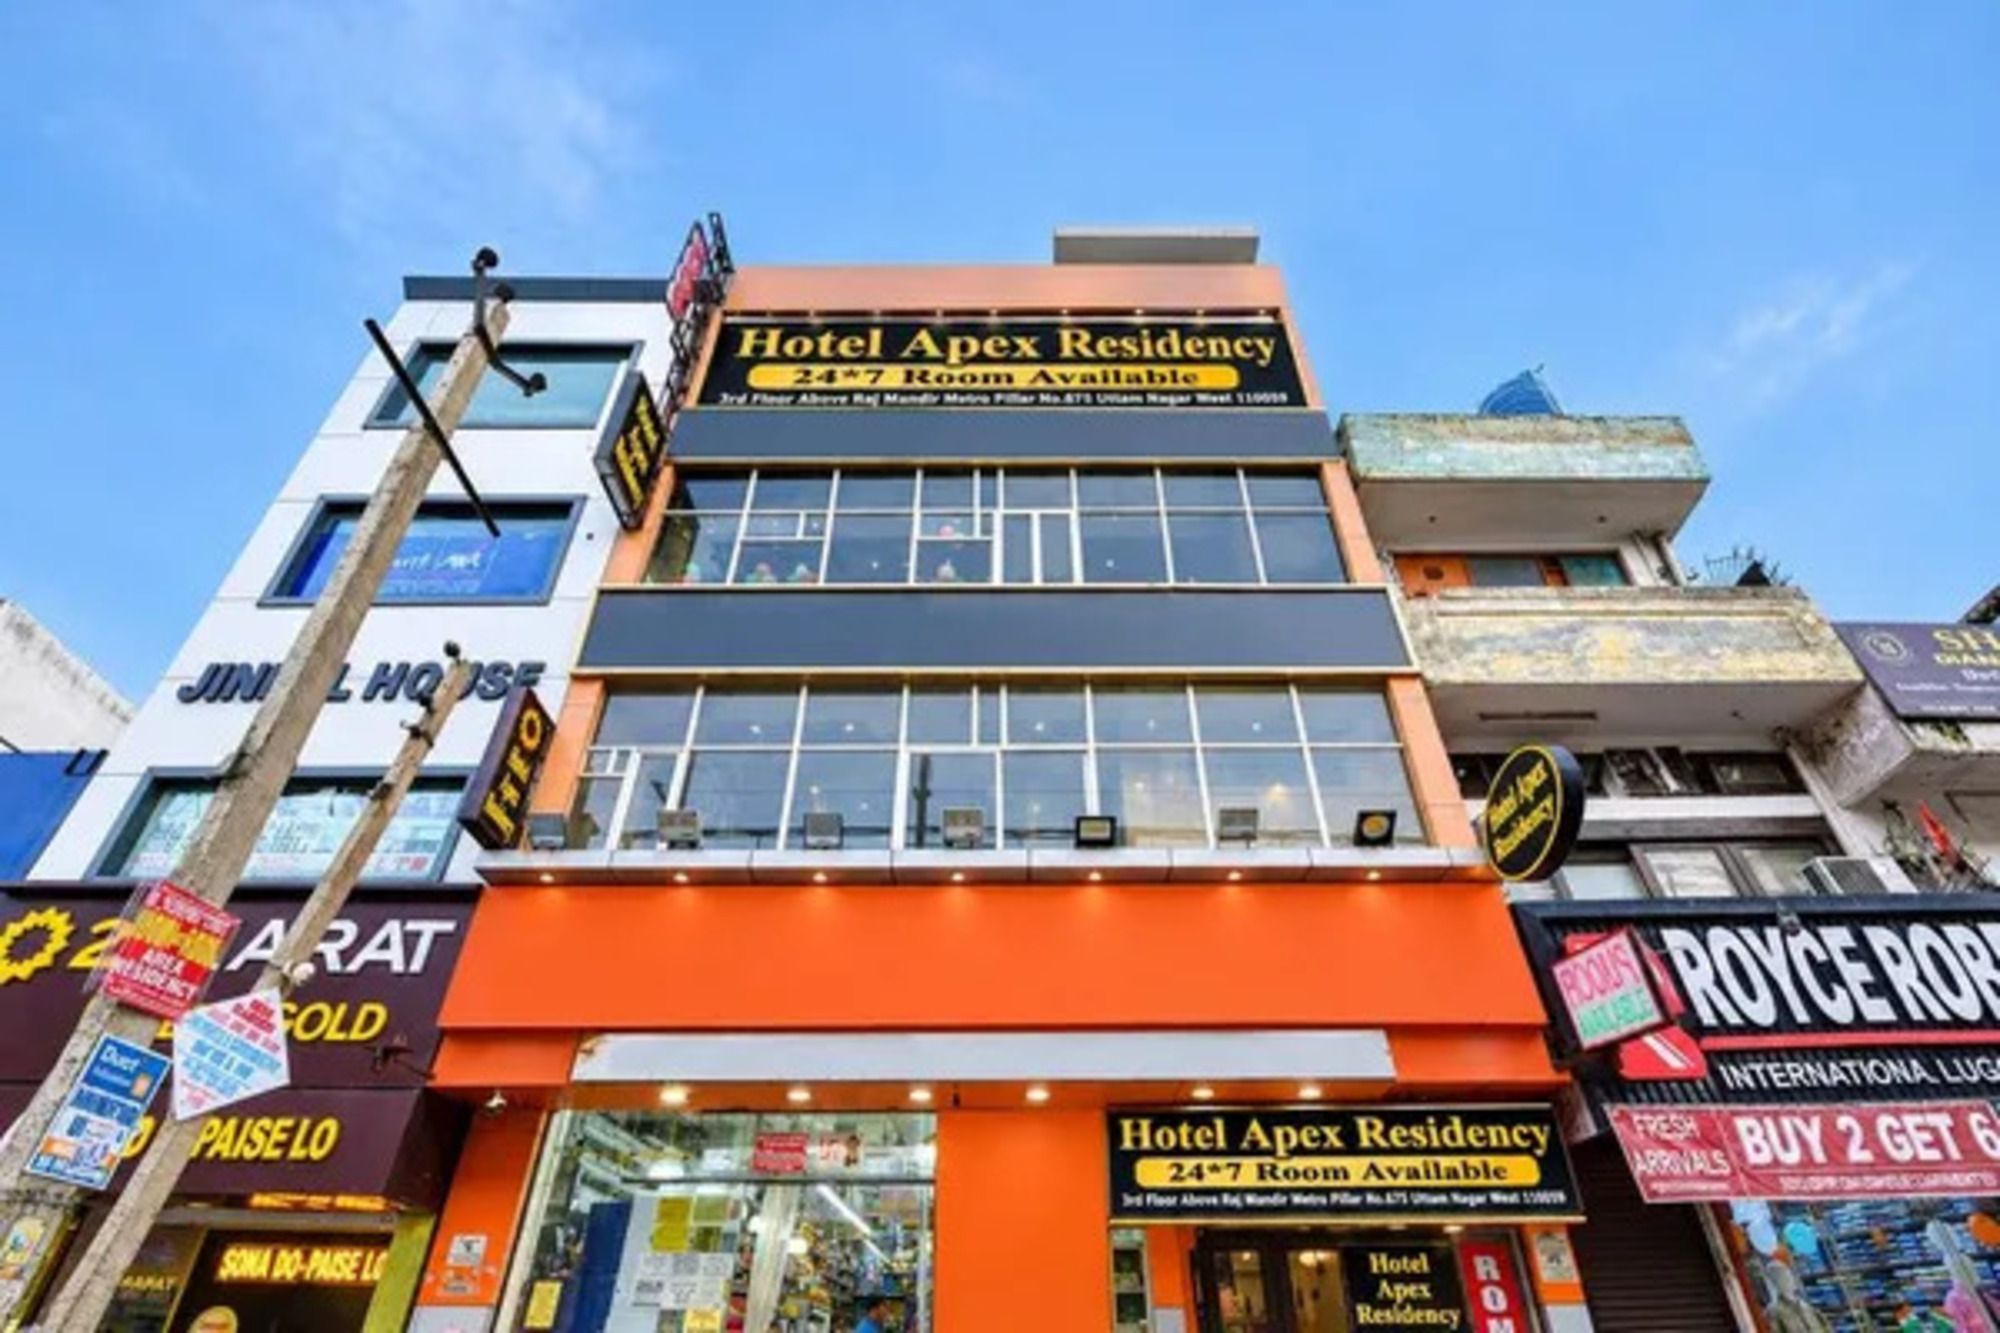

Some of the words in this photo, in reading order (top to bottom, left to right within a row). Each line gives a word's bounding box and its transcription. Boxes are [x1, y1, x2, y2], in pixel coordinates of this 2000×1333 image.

[734, 327, 883, 359] Hotel
[901, 328, 1042, 364] Apex
[1058, 328, 1275, 367] Residency
[903, 368, 1014, 385] Room
[1028, 368, 1199, 386] Available
[176, 662, 353, 703] JINL
[1658, 925, 1899, 1027] ROYCE
[1861, 922, 2000, 1022] ROB
[1935, 1056, 2000, 1084] LUG
[287, 1116, 340, 1161] LO
[1119, 1117, 1227, 1150] Hotel
[1240, 1117, 1346, 1159] Apex
[1353, 1115, 1549, 1157] Residency
[1632, 1111, 1702, 1142] FRESH
[1733, 1113, 1828, 1166] BUY
[1834, 1113, 1875, 1164] 2
[1876, 1111, 1963, 1164] GET
[1256, 1161, 1350, 1182] Room
[1361, 1158, 1509, 1182] Available
[1631, 1148, 1732, 1176] ARRIVALS
[1368, 1251, 1432, 1275] Hotel
[1376, 1279, 1433, 1304] Apex
[1355, 1302, 1462, 1331] Residency
